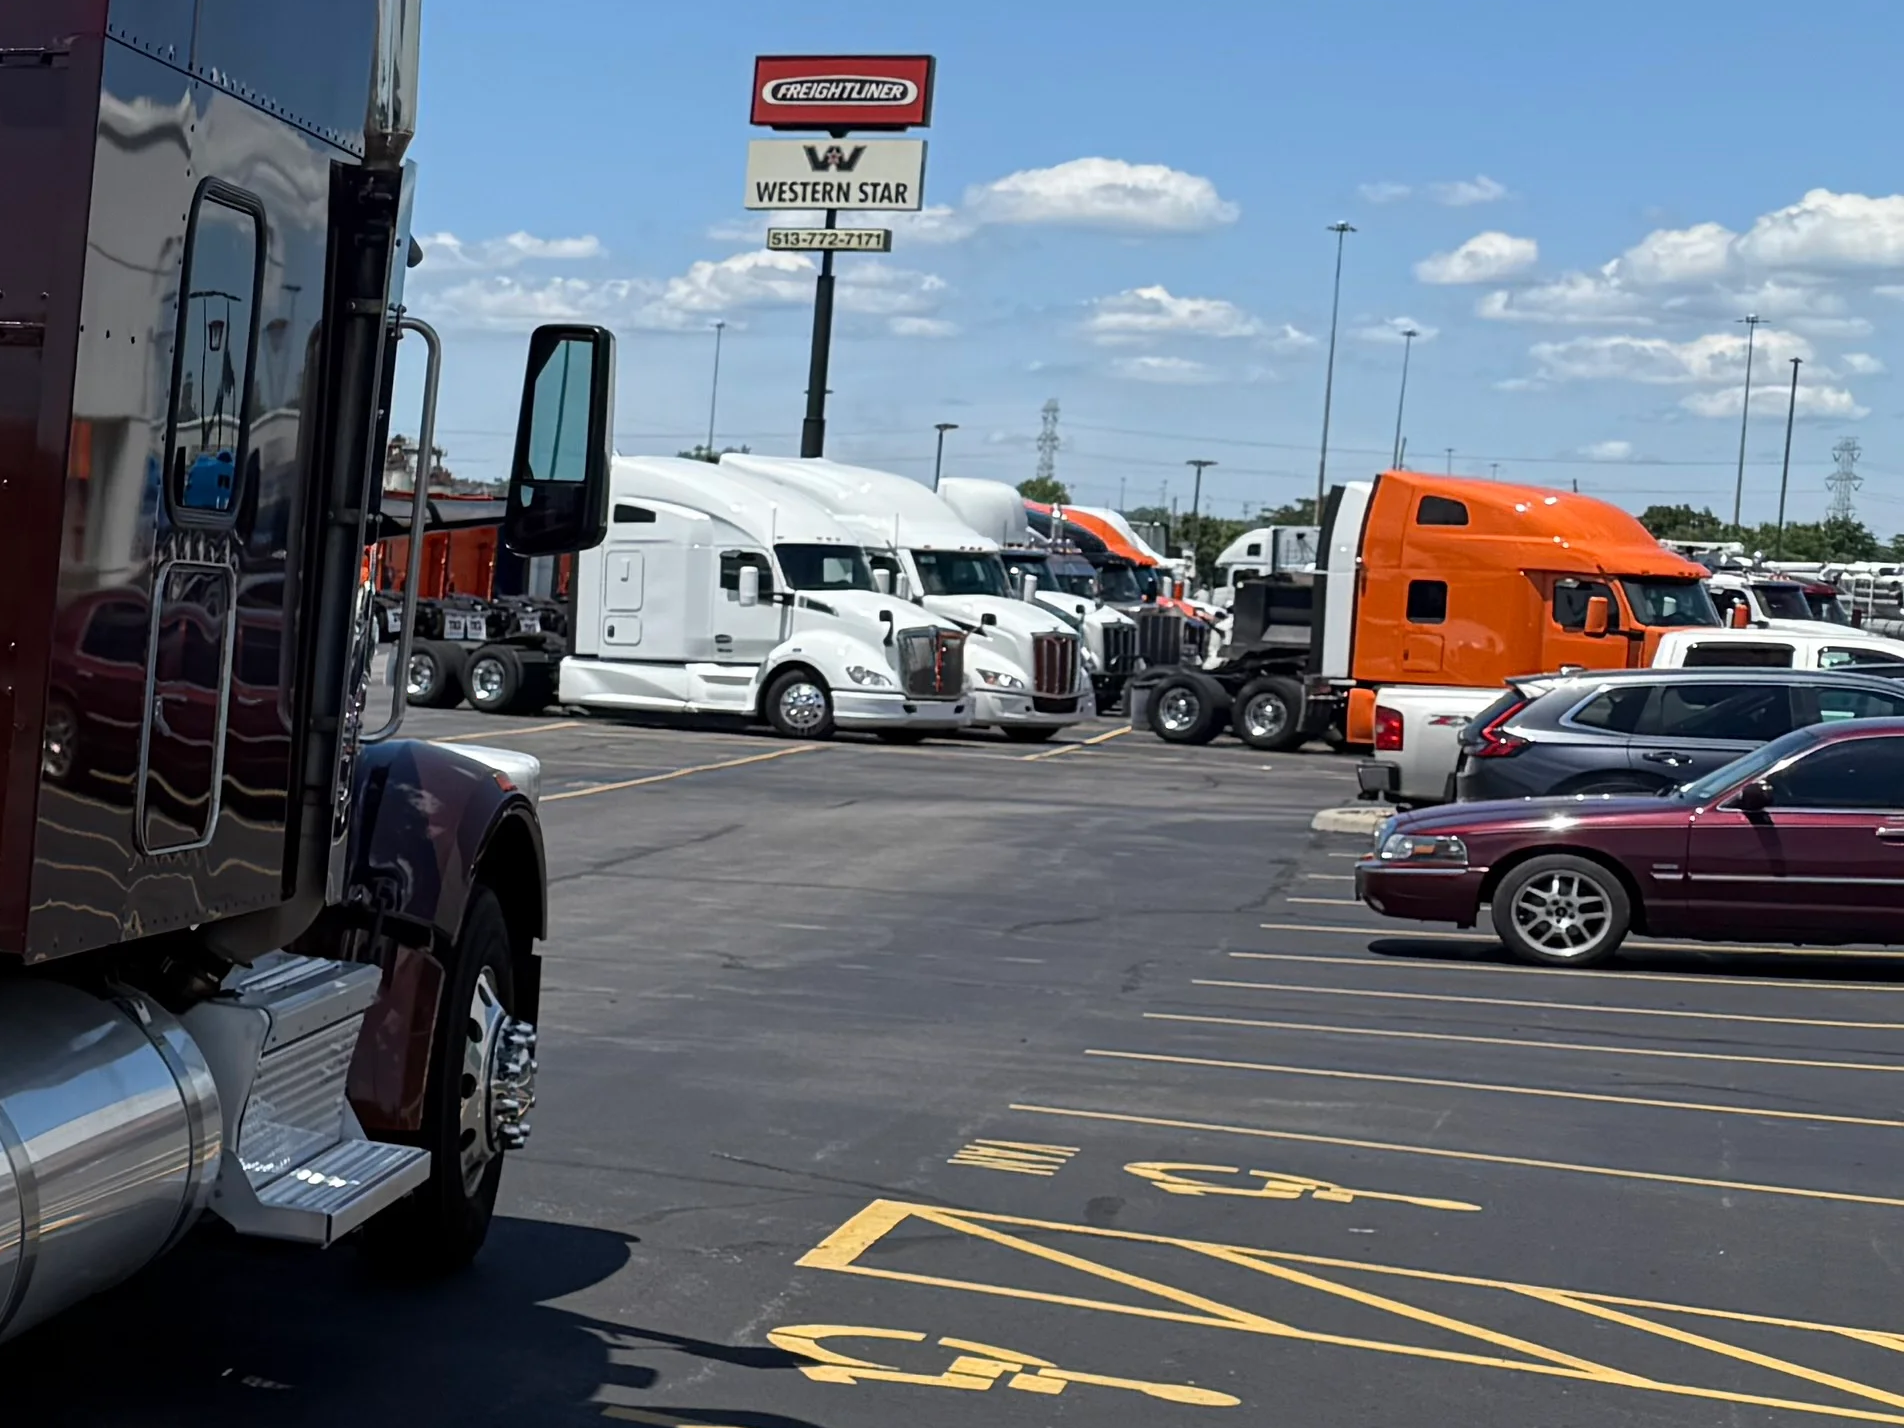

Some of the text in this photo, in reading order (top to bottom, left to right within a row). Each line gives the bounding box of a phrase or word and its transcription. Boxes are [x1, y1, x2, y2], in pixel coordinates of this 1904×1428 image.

[777, 82, 904, 100] FREIGHTLINER
[756, 181, 909, 204] WESTERN STAR
[771, 232, 882, 247] 513-772-7171
